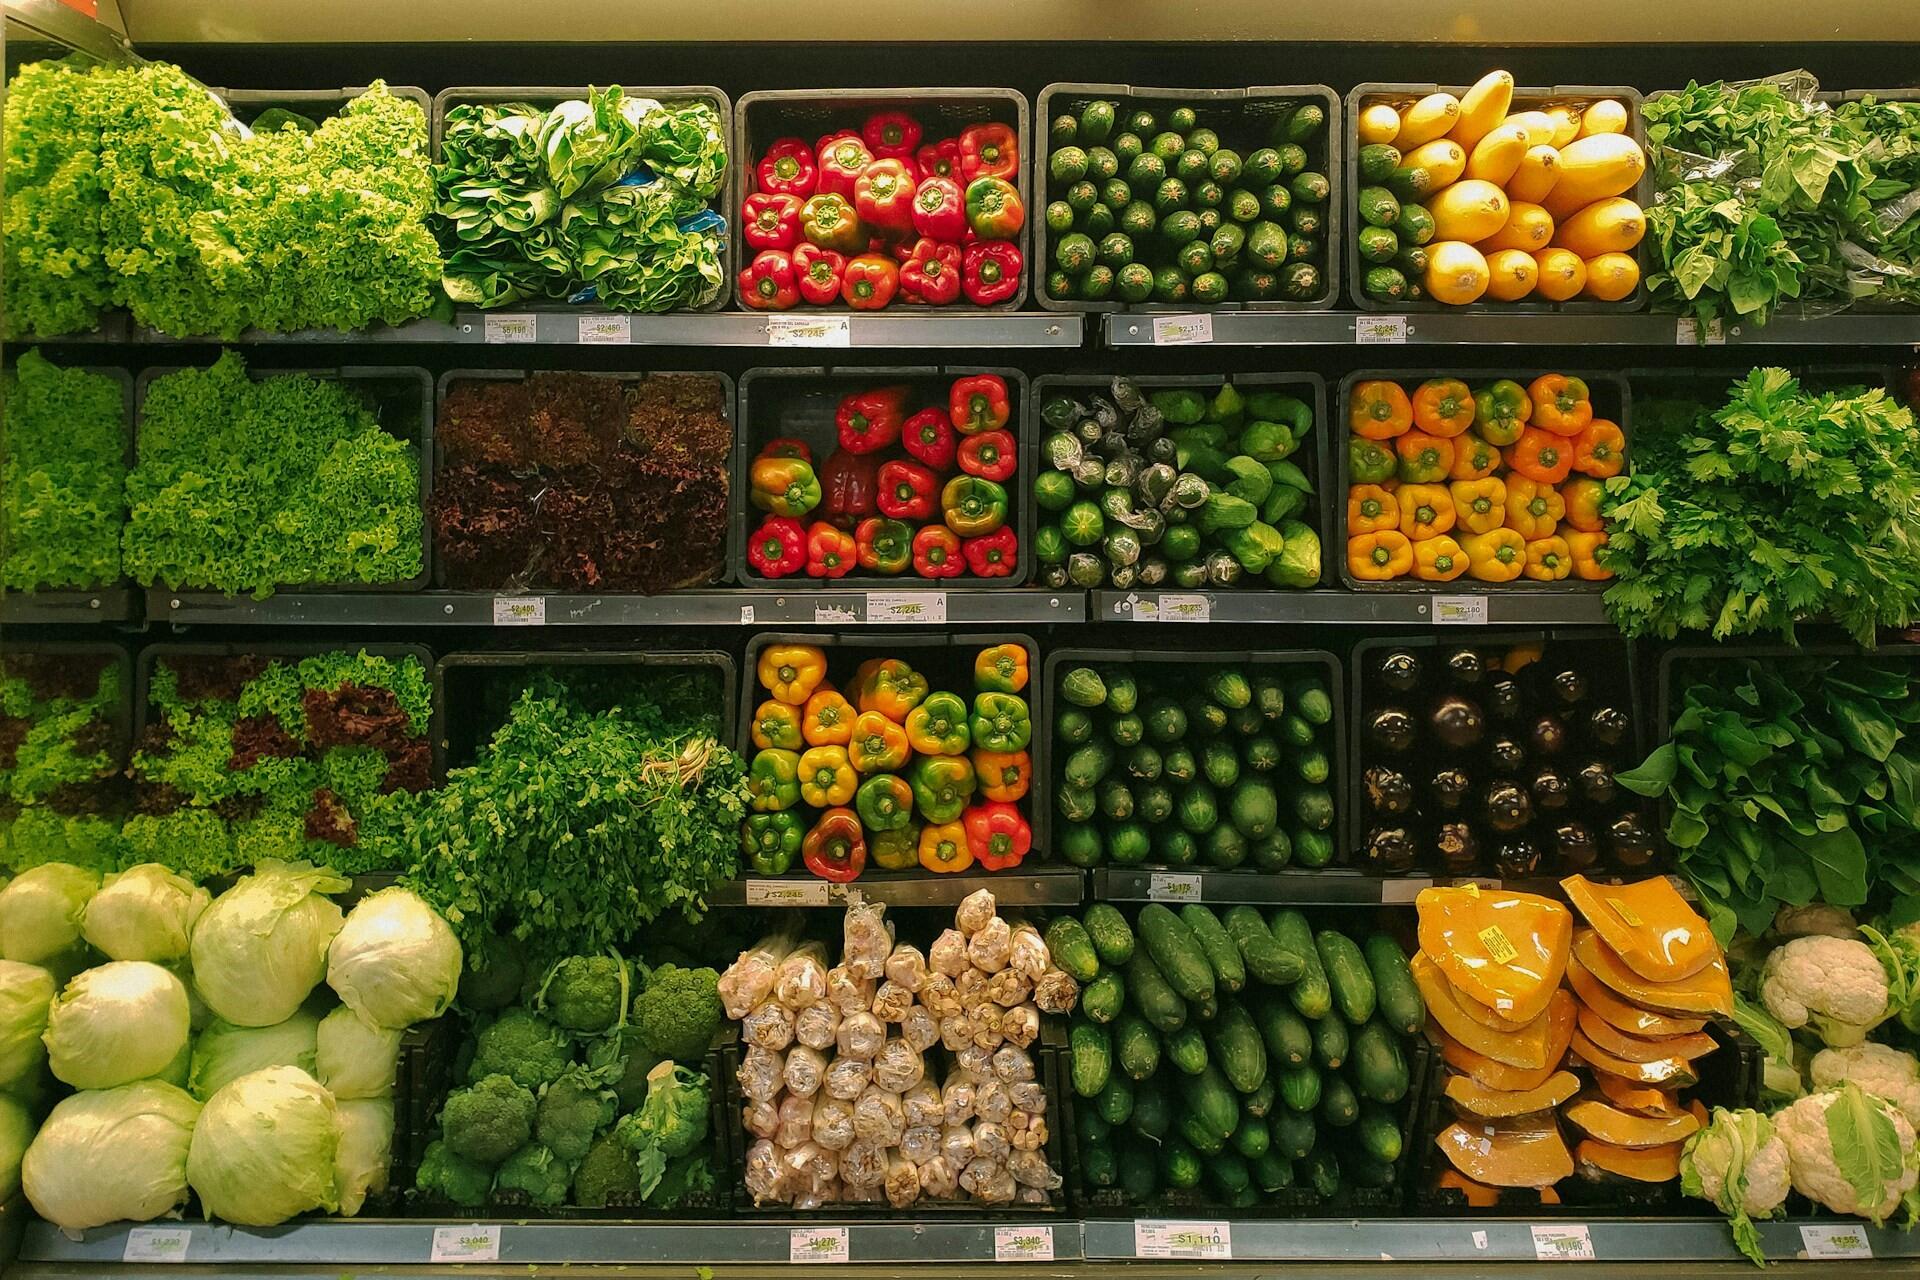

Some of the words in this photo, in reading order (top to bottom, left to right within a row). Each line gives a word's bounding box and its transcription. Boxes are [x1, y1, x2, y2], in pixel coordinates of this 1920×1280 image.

[840, 321, 849, 330] A
[936, 597, 944, 606] A
[890, 605, 922, 615] $2,245
[771, 888, 804, 898] $2,245
[819, 885, 826, 893] A
[1213, 1226, 1219, 1234] A
[1178, 1234, 1220, 1244] $1,110
